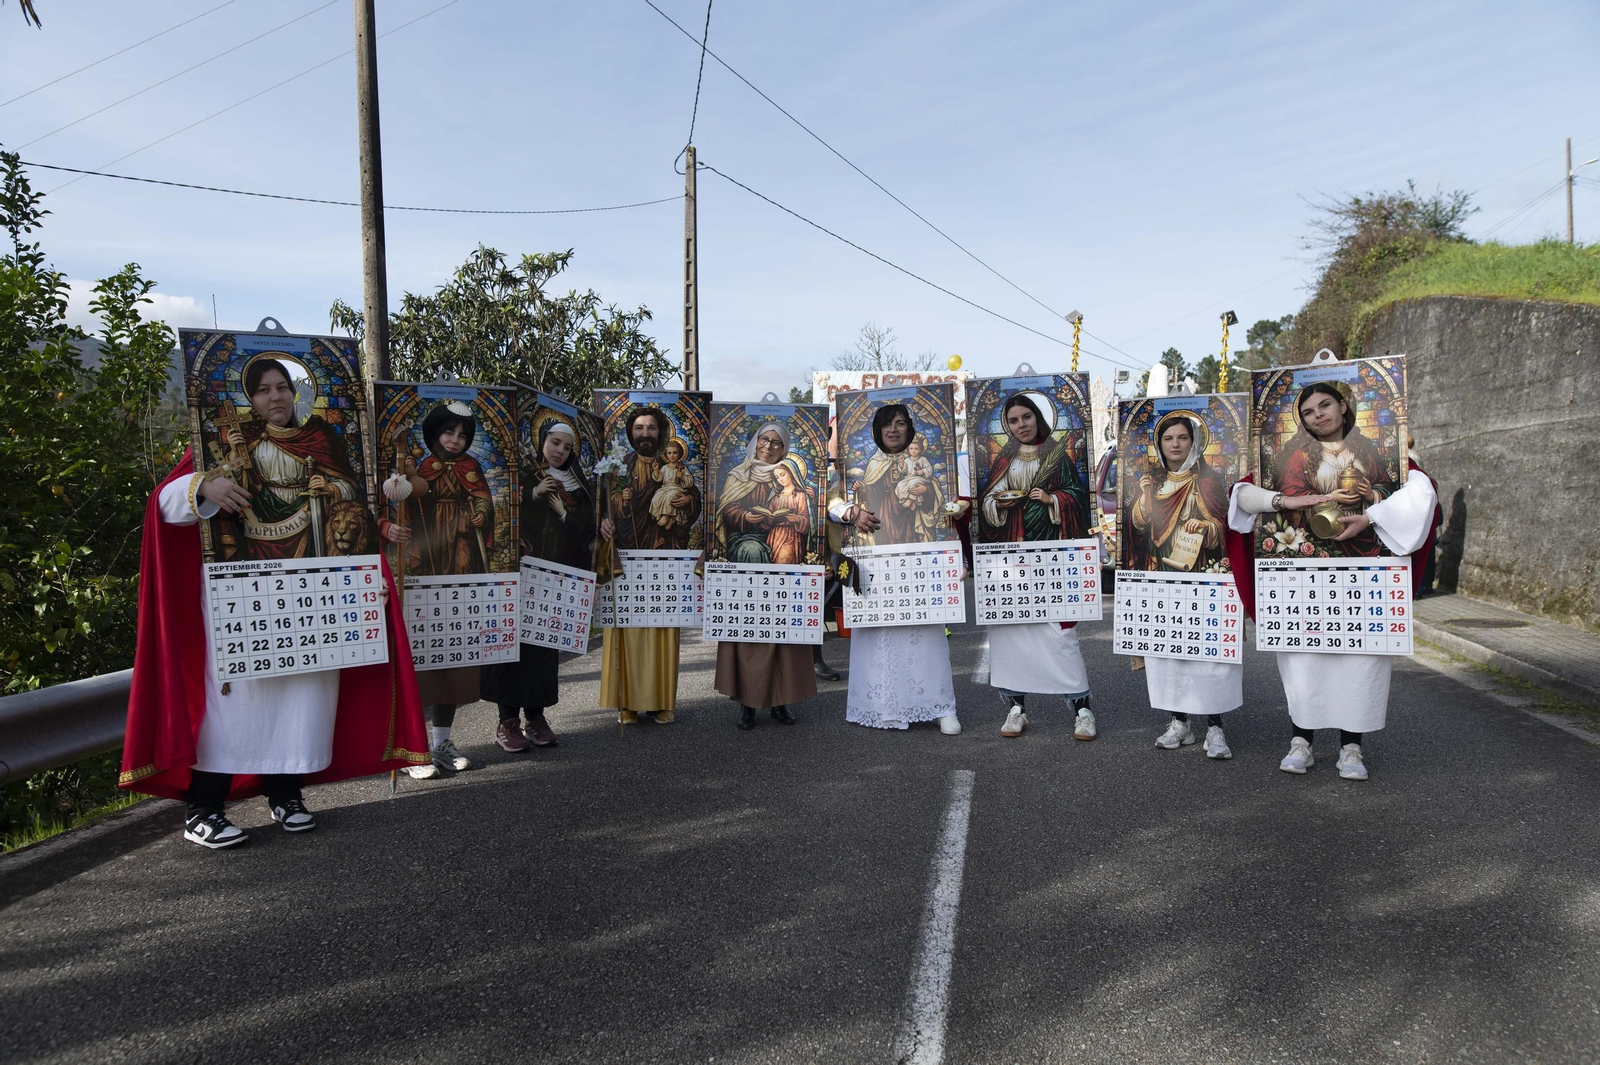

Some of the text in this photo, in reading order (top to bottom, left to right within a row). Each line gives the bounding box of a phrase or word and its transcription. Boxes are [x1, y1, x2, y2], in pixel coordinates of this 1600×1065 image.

[248, 515, 307, 536] EUPHEMIA
[1179, 535, 1198, 546] SANTA
[1174, 543, 1197, 554] PACIENCIA
[208, 563, 261, 573] SEPTIEMBRE
[866, 582, 958, 595] 14 15 16 17 18 19
[984, 580, 1096, 592] 14 15 16 17 18 19 20
[868, 596, 959, 608] 21 22 23 24 25 26
[985, 594, 1096, 606] 21 22 23 24 25 26 27
[525, 600, 587, 620] 13 14 15 16 17
[713, 602, 724, 610] 13
[728, 603, 739, 611] 14
[744, 603, 755, 611] 15
[760, 604, 771, 612] 16
[792, 604, 803, 613] 18
[808, 605, 819, 613] 19
[1266, 606, 1405, 616] 13 14 15 16 17 18 19
[225, 610, 378, 634] 14 15 16 17 18 19 20
[411, 618, 514, 634] 14 15 16 17 18 19
[523, 614, 585, 634] 20 21 22 23 24
[712, 615, 818, 627] 20 21 22 23 24 25 26
[1123, 613, 1236, 628] 11 12 13 14 15 16 17
[1267, 621, 1406, 632] 20 21 22 23 24 25 26
[227, 628, 380, 654] 21 22 23 24 25 26 27
[412, 640, 425, 650] 21
[430, 638, 444, 648] 22
[449, 637, 462, 646] 23
[467, 636, 480, 645] 24
[485, 634, 497, 644] 25
[502, 632, 514, 642] 26
[1122, 627, 1236, 643] 18 19 20 21 22 23 24
